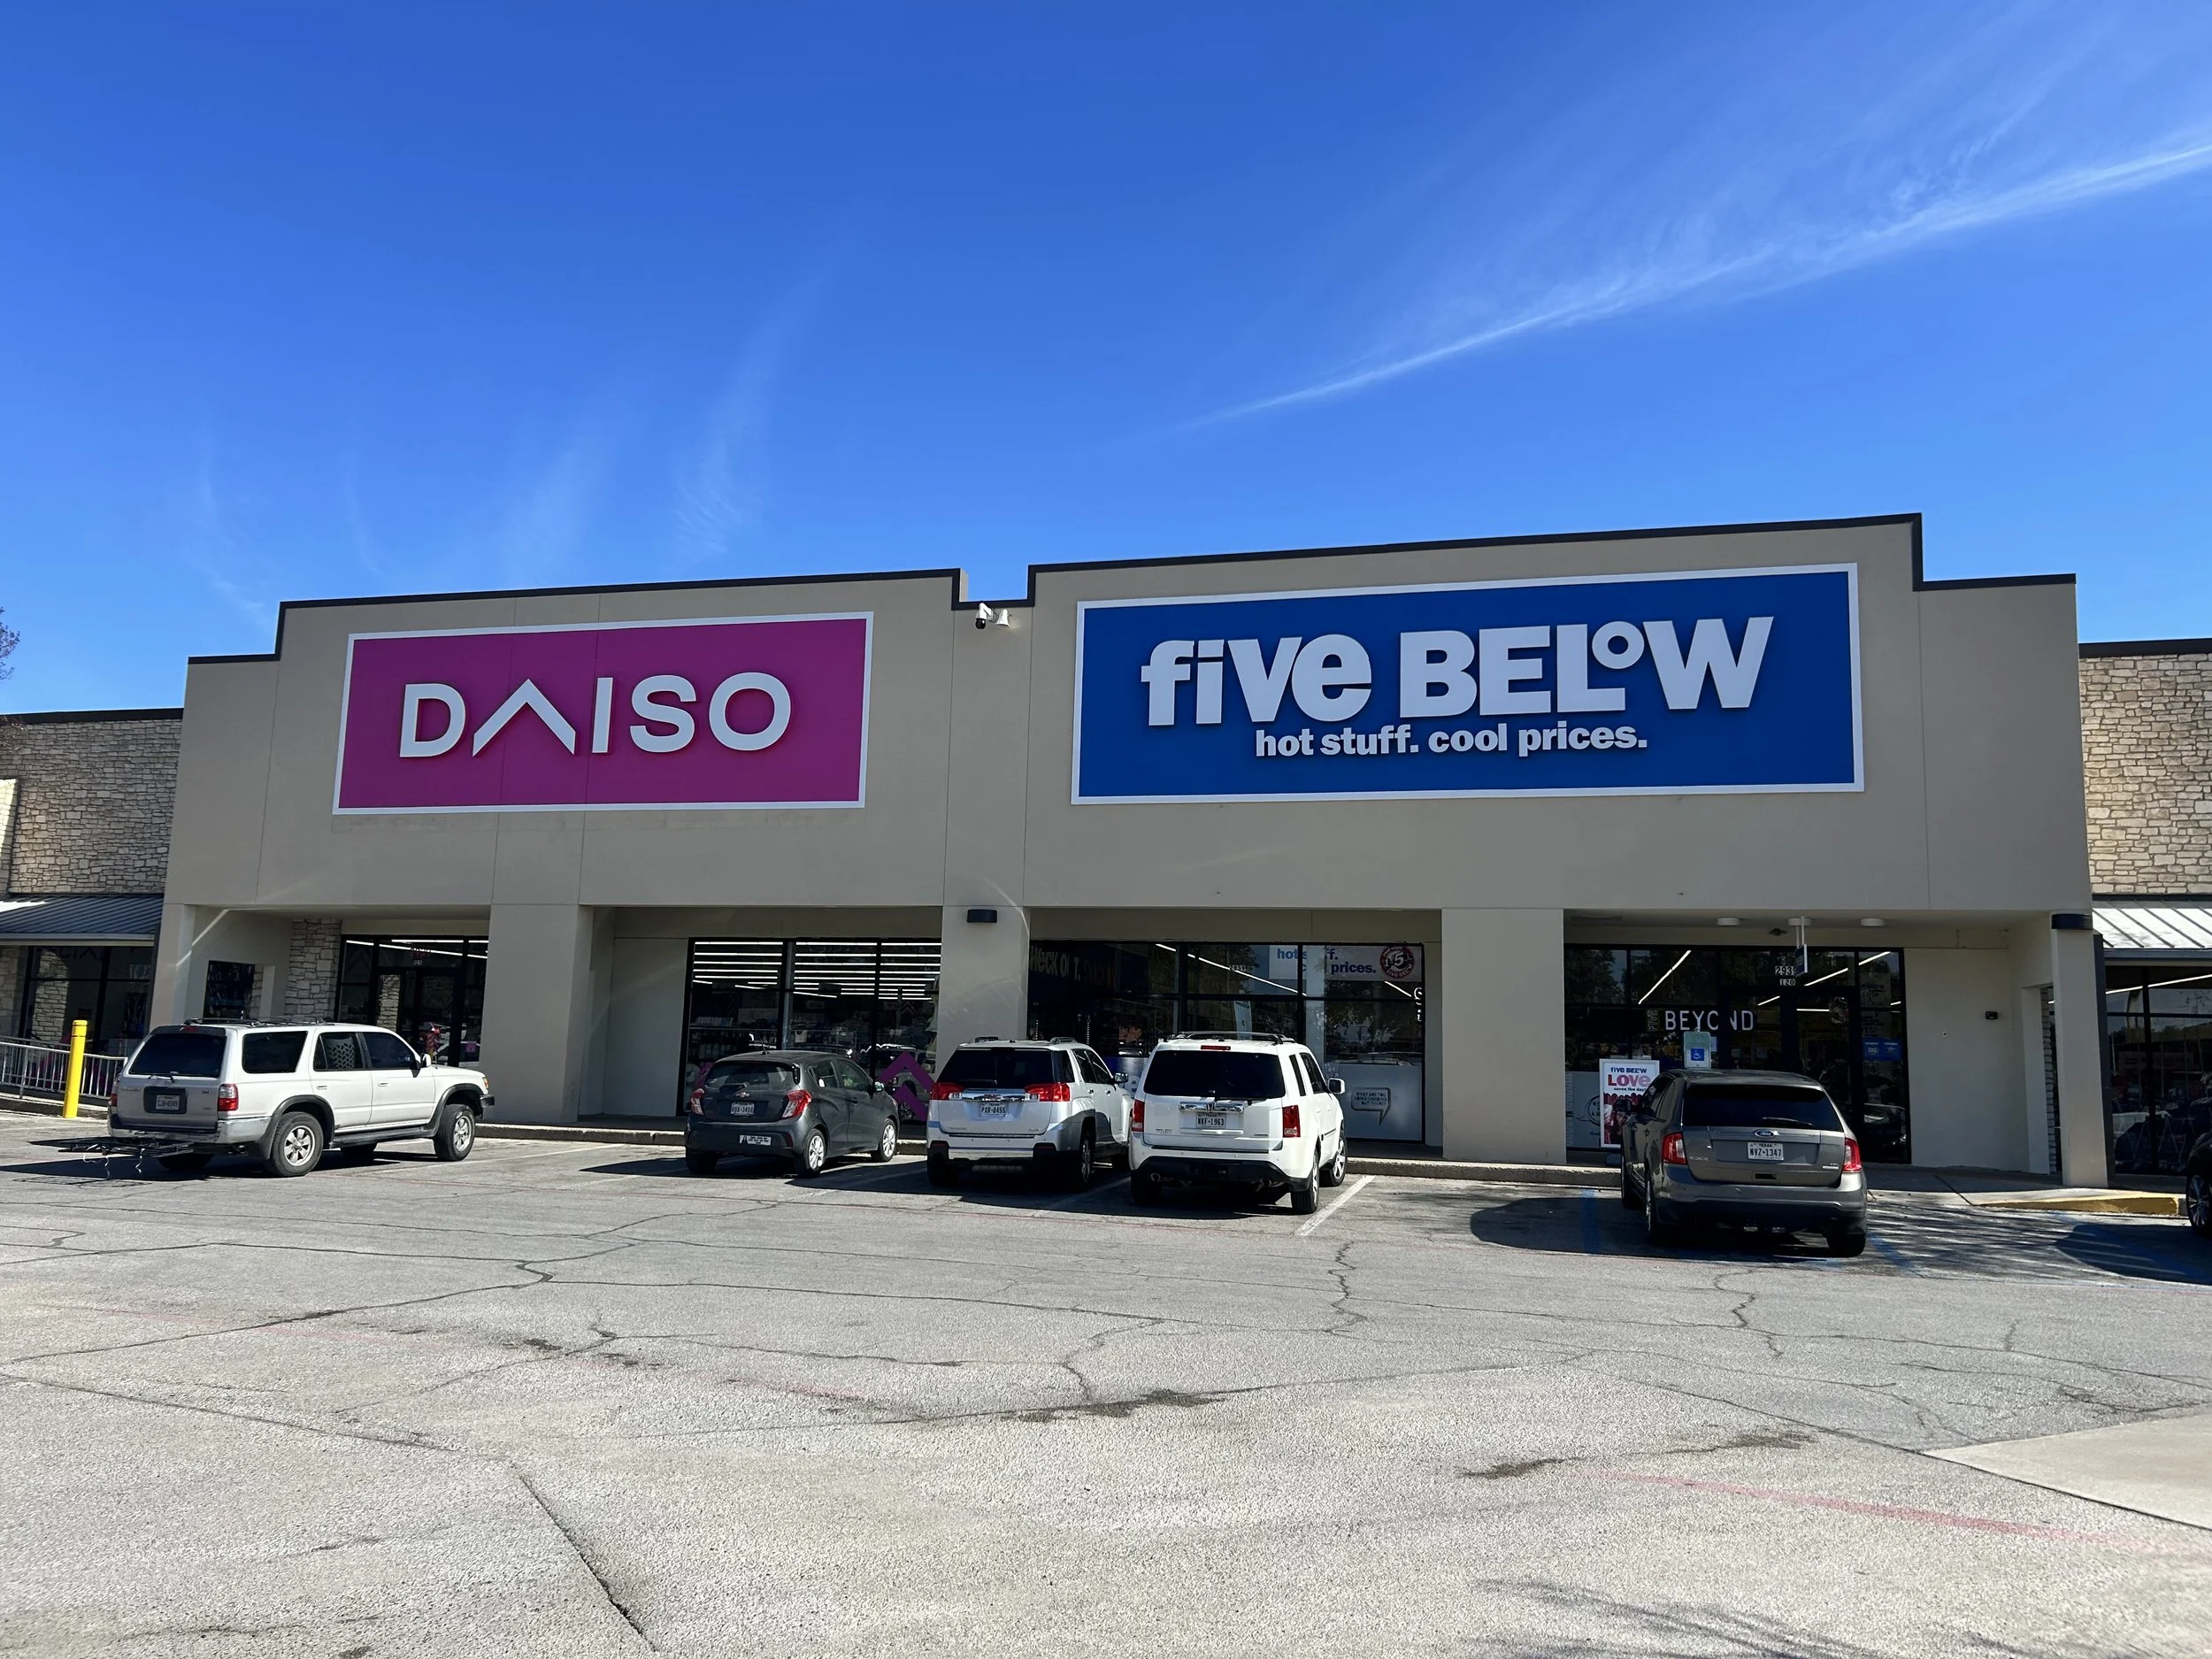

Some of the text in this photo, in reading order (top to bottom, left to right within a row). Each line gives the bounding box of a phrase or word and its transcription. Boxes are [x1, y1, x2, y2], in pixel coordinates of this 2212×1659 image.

[398, 671, 792, 758] DAISO
[1256, 721, 1648, 759] hot stuff. cool prices.
[1331, 962, 1377, 973] prices.
[1749, 1148, 1782, 1157] NVZ-1347
